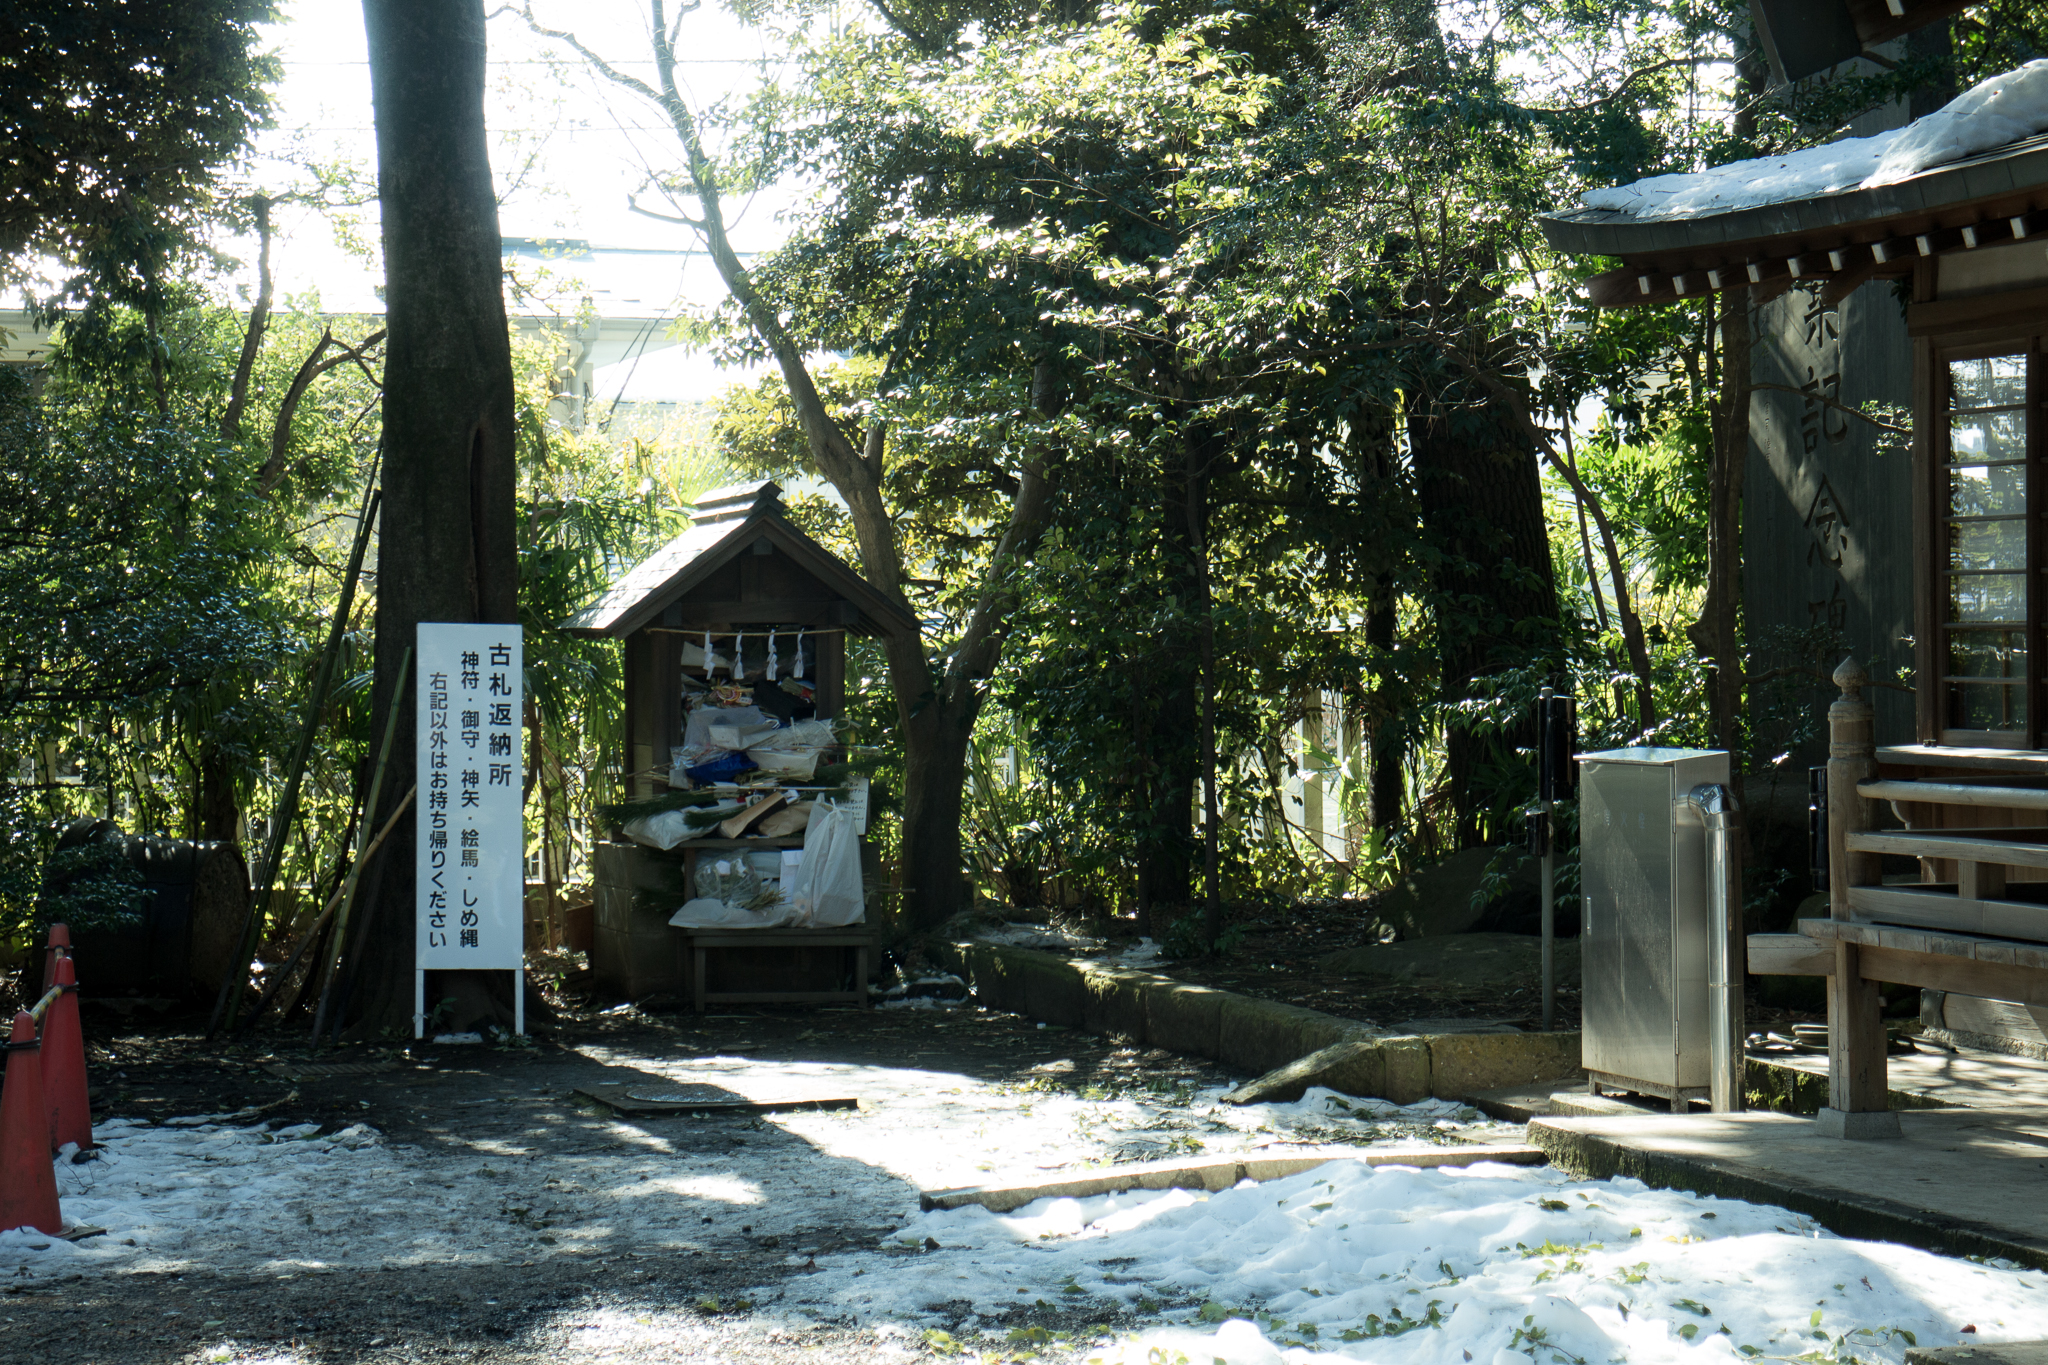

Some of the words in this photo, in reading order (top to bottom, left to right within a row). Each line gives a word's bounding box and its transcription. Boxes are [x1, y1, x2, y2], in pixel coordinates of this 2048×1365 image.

[429, 672, 448, 948] 右記以外はお持ち帰りください
[488, 643, 512, 787] 古札返納所
